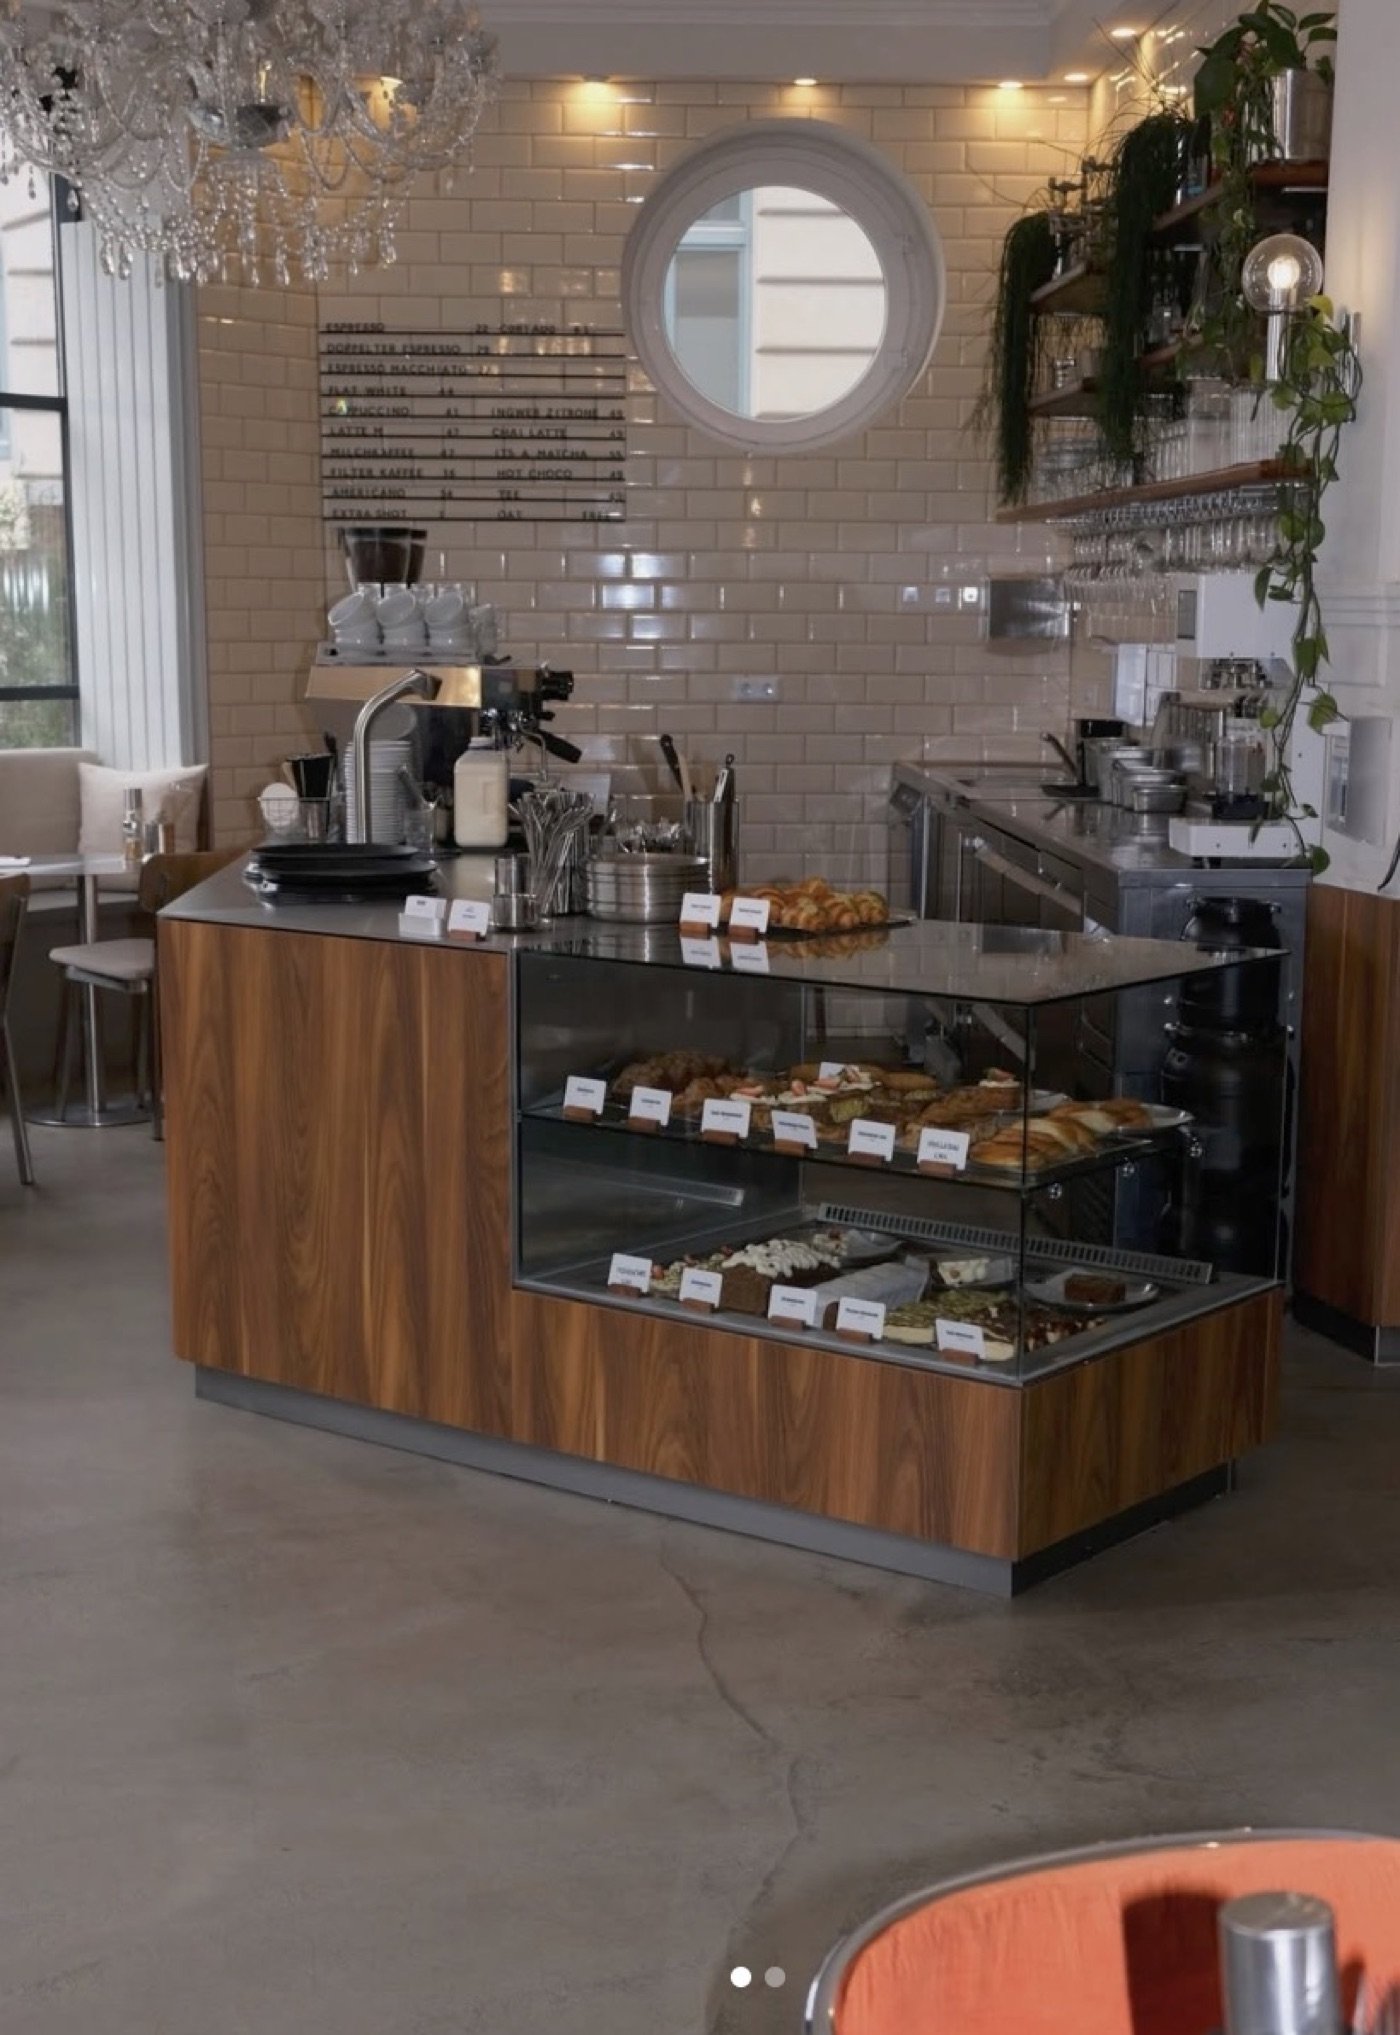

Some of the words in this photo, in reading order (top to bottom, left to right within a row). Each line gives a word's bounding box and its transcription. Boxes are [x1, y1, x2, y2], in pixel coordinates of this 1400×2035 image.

[326, 322, 384, 333] ESPRESSO
[499, 324, 555, 335] CORTADO
[328, 343, 396, 354] DOPPELTER
[402, 344, 461, 355] ESPRESSO
[328, 363, 385, 374] ESPRESSO
[391, 364, 467, 375] MACCHIATO
[328, 385, 358, 396] FLAT
[365, 385, 406, 396] WHITE
[490, 407, 539, 418] INGWER
[546, 407, 598, 419] ZITRONE
[330, 426, 367, 437] LATTE
[374, 426, 384, 437] M
[491, 427, 523, 438] CHAI
[528, 427, 567, 438] LATTE
[330, 447, 414, 458] MILCHKAFFEE
[538, 448, 588, 460] MATCHA
[330, 467, 374, 478] FILTER
[380, 467, 424, 478] KAFFEE
[496, 469, 522, 480] HOT
[528, 468, 573, 480] CHOCO
[332, 487, 407, 499] AMERICANO
[499, 489, 520, 500] TEE
[333, 508, 371, 519] EXTRA
[375, 508, 408, 519] SHOT
[497, 509, 522, 520] OAT
